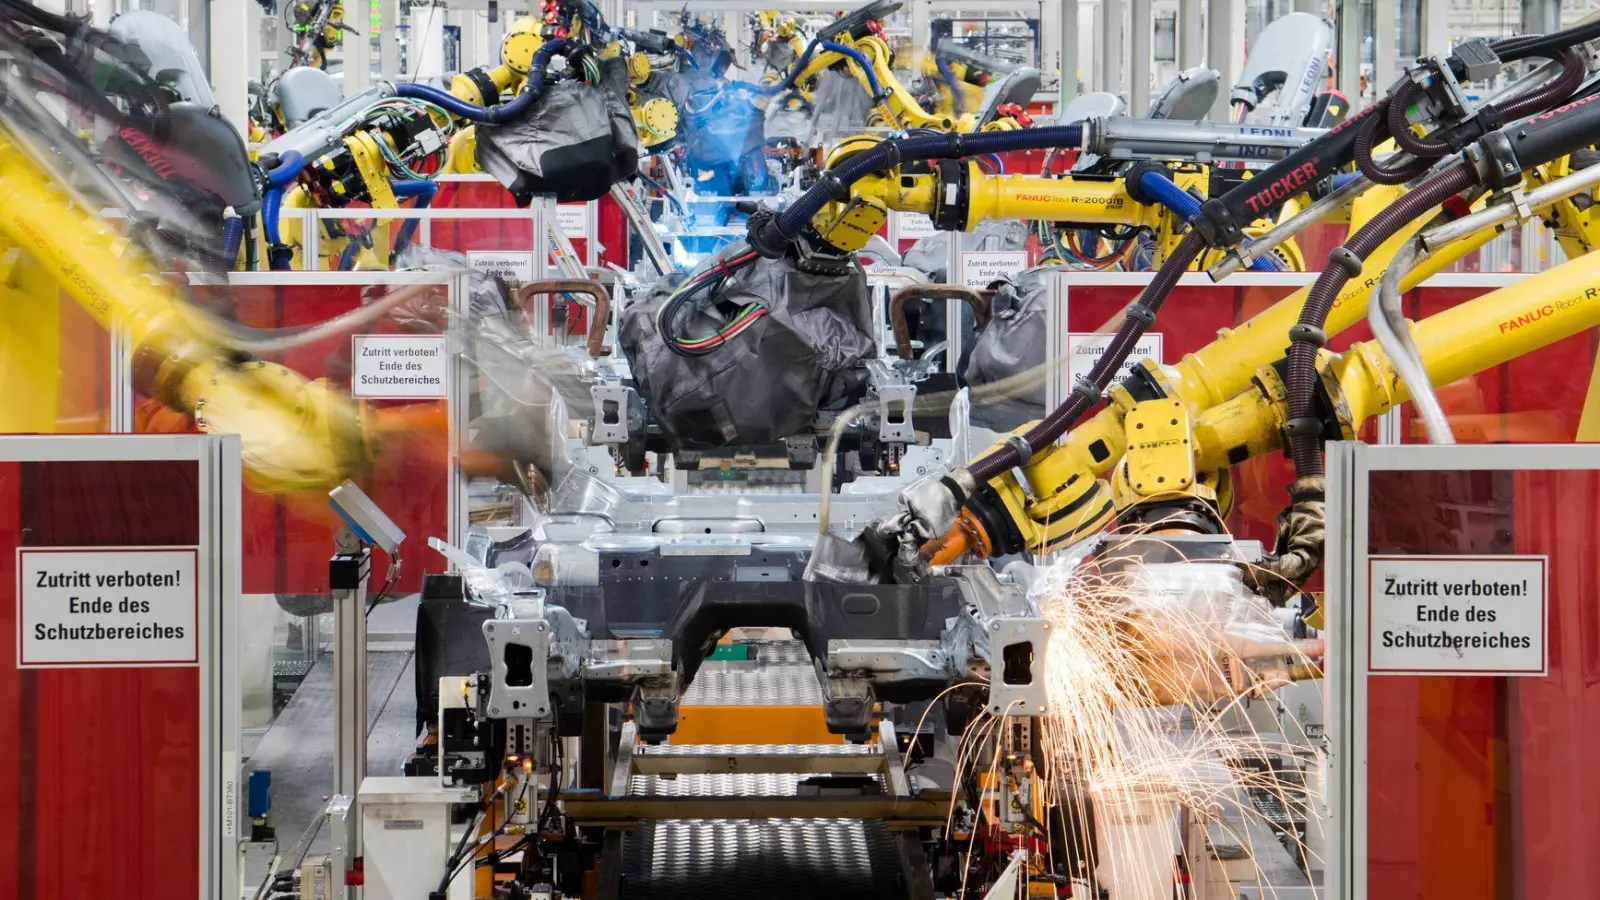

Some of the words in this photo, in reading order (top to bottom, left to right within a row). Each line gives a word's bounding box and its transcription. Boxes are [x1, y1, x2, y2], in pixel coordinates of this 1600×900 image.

[1300, 57, 1321, 94] LEONI
[1015, 193, 1051, 203] FANUC
[1499, 304, 1554, 334] FANUC
[1555, 295, 1584, 312] Robot
[362, 347, 391, 357] Zutritt
[393, 347, 438, 357] verboten!
[1075, 345, 1105, 355] Zutritt
[379, 361, 403, 371] Ende
[405, 361, 422, 371] des
[361, 374, 440, 385] Schutzbereiches
[36, 571, 91, 588] Zutritt
[96, 570, 181, 588] verboten!
[1384, 578, 1439, 596] Zutritt
[1443, 579, 1528, 596] verboten!
[69, 596, 113, 614] Ende
[118, 596, 150, 613] des
[1416, 604, 1460, 622] Ende
[1465, 605, 1497, 622] des
[35, 622, 185, 640] Schutzbereiches
[1382, 630, 1531, 649] Schutzbereiches
